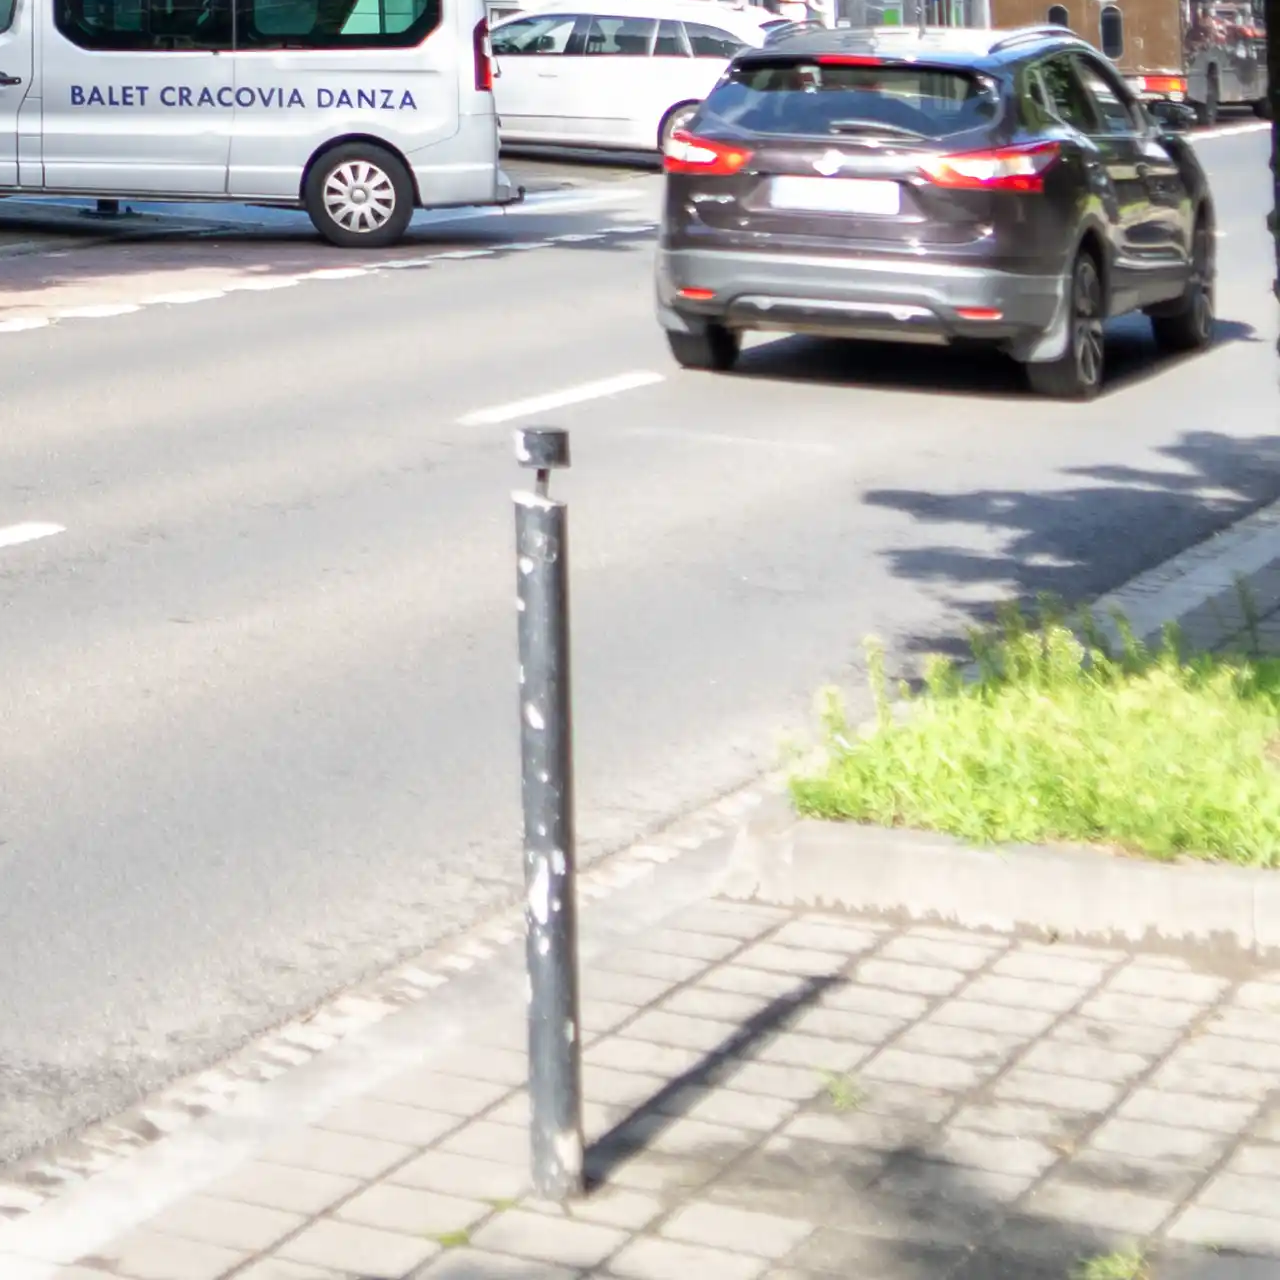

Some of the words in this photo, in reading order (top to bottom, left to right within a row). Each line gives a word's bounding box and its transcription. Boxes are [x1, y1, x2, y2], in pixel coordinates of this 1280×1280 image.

[70, 85, 149, 106] BALET
[159, 86, 306, 108] CRACOVIA
[317, 88, 418, 110] DANZA
